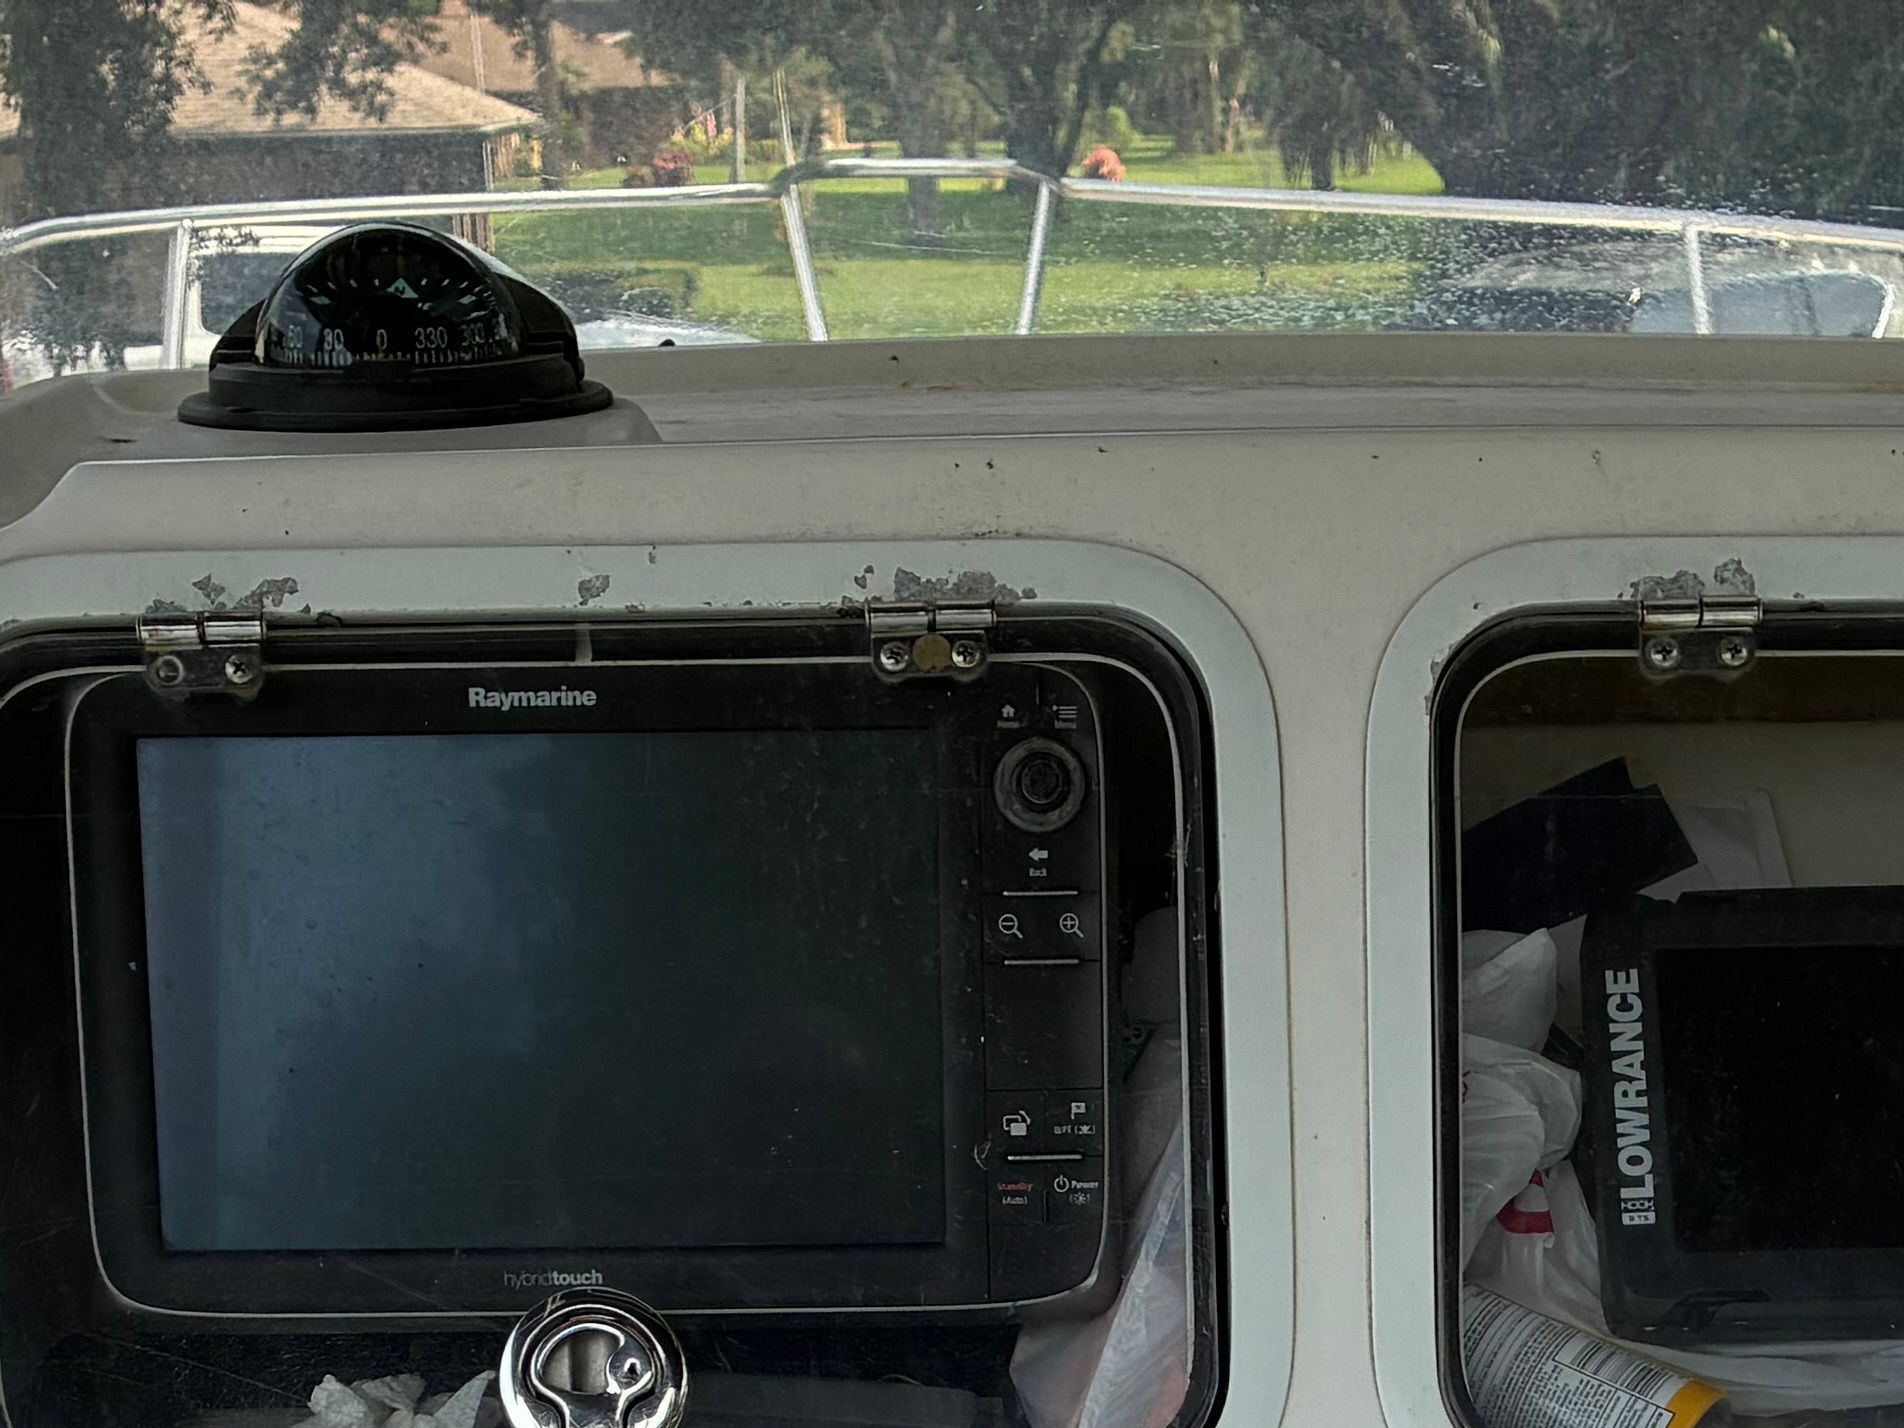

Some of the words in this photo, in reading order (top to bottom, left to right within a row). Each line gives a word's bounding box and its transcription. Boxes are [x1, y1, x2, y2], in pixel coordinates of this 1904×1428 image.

[414, 326, 448, 349] 330
[468, 685, 597, 711] Raymarine
[1604, 968, 1655, 1199] LOWRANCE
